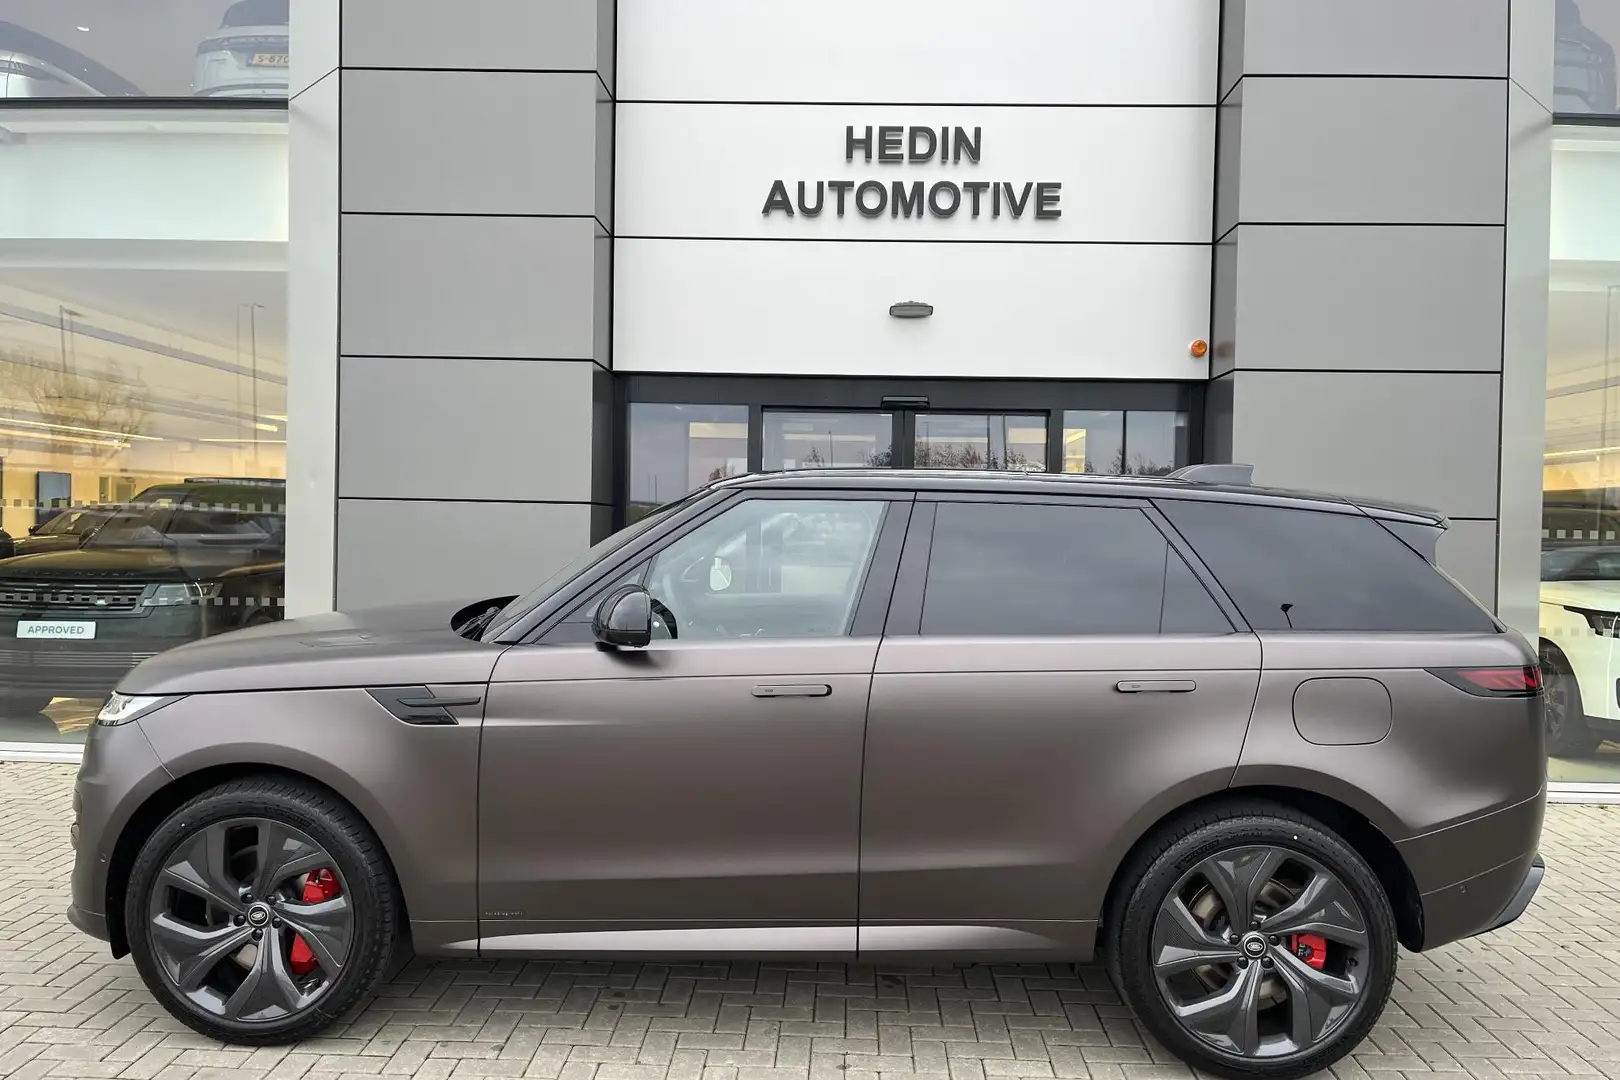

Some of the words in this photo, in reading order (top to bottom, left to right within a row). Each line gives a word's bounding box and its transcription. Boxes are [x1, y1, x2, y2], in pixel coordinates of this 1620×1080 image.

[845, 125, 982, 163] HEDIN
[761, 179, 1062, 217] AUTOMOTIVE
[27, 625, 84, 635] APPROVED
